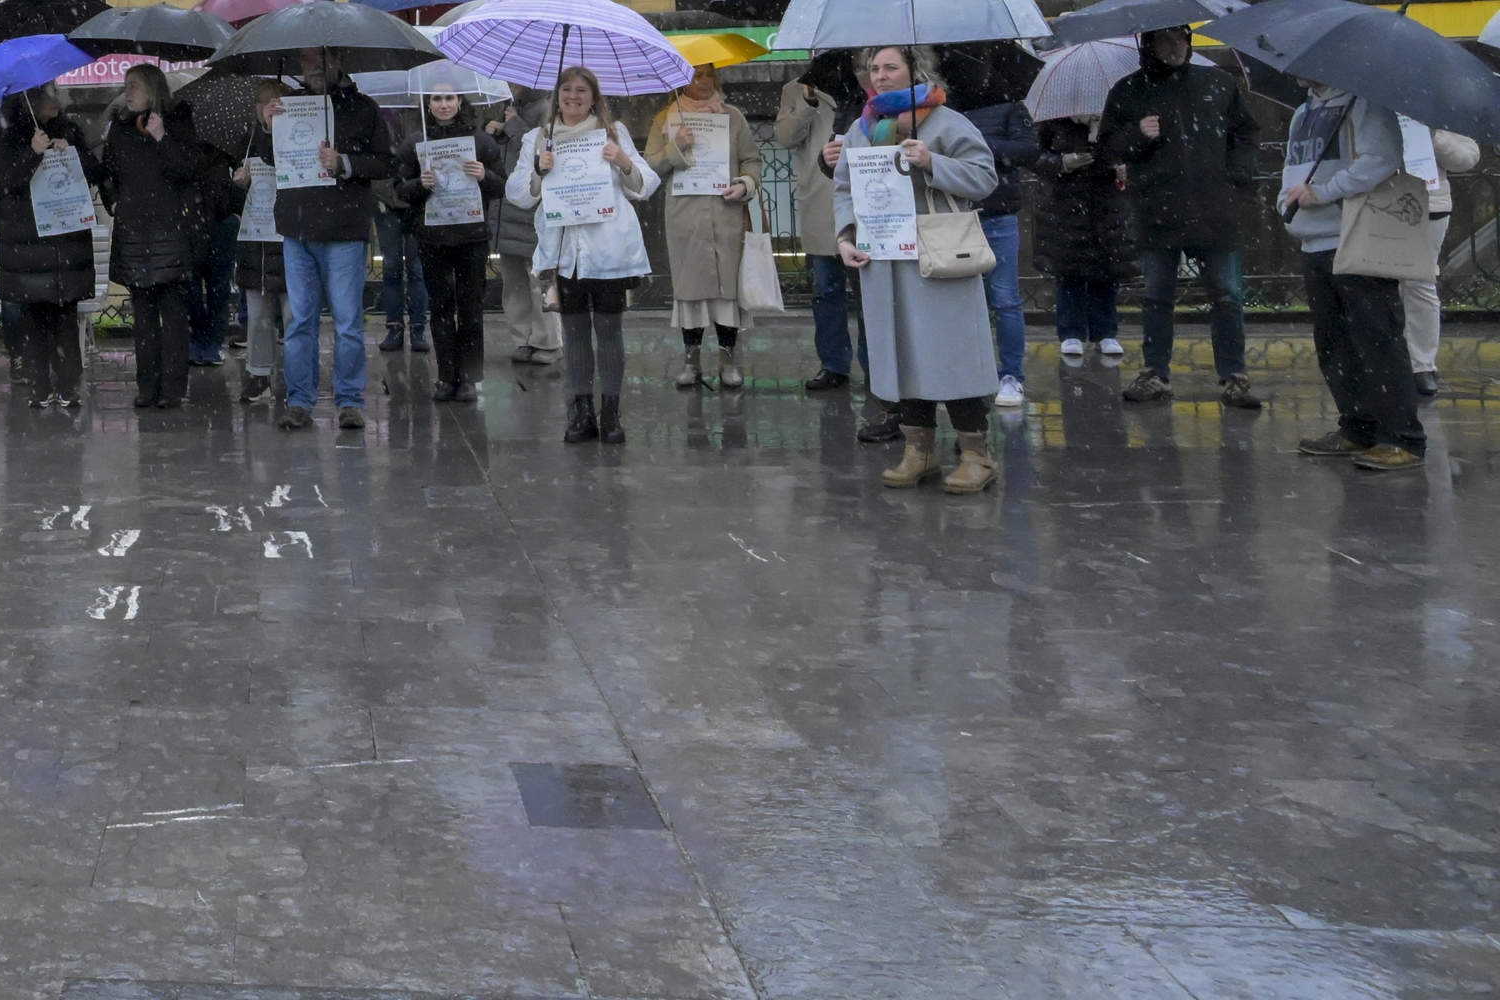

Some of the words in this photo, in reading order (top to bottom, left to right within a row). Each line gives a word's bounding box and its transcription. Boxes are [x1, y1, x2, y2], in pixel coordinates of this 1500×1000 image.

[556, 138, 588, 146] DONOSTIAN
[553, 144, 577, 152] KARAREN
[80, 215, 94, 223] LAB
